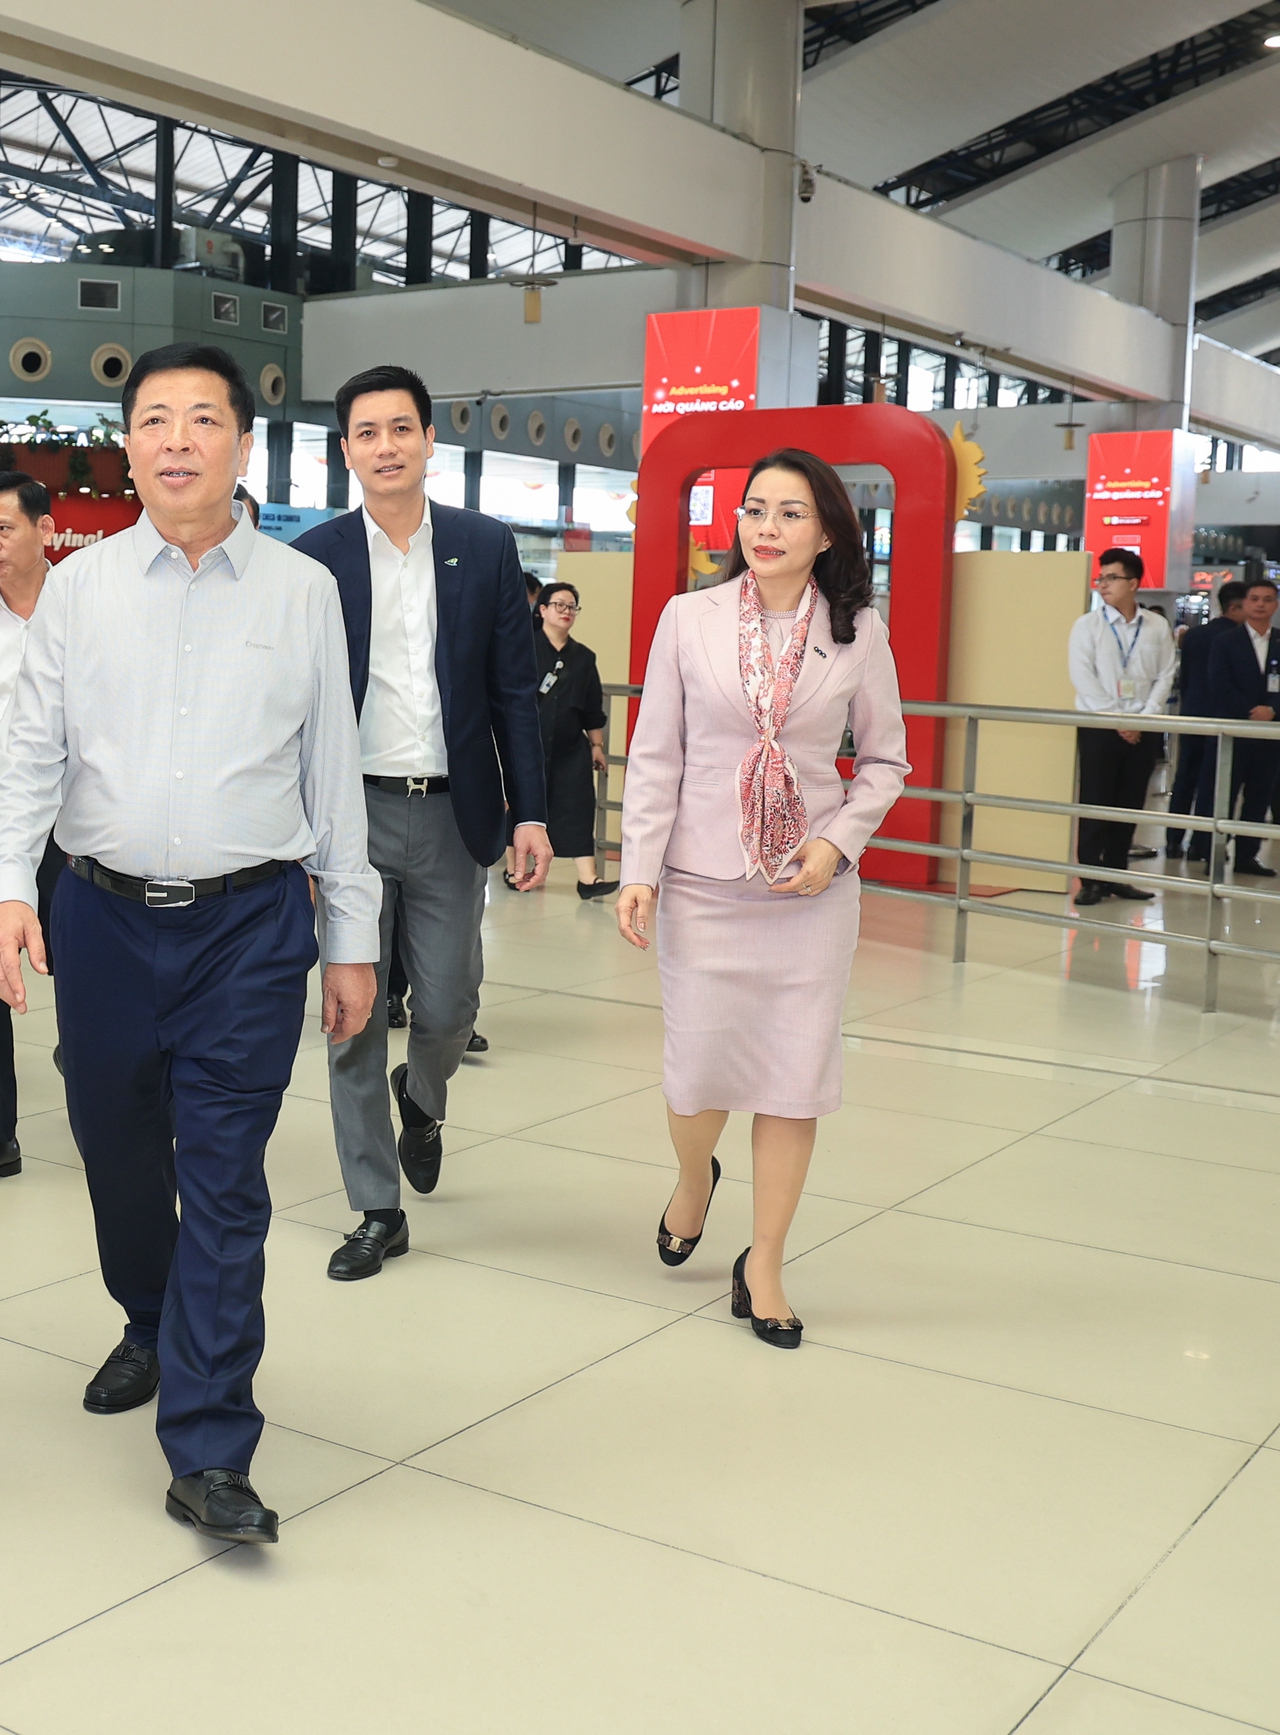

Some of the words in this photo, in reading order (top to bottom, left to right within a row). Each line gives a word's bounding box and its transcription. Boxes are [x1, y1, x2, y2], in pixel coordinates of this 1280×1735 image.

[668, 384, 729, 396] Advertising
[651, 400, 675, 413] MỜI
[675, 398, 718, 414] QUẢNG
[718, 398, 745, 411] CÁO
